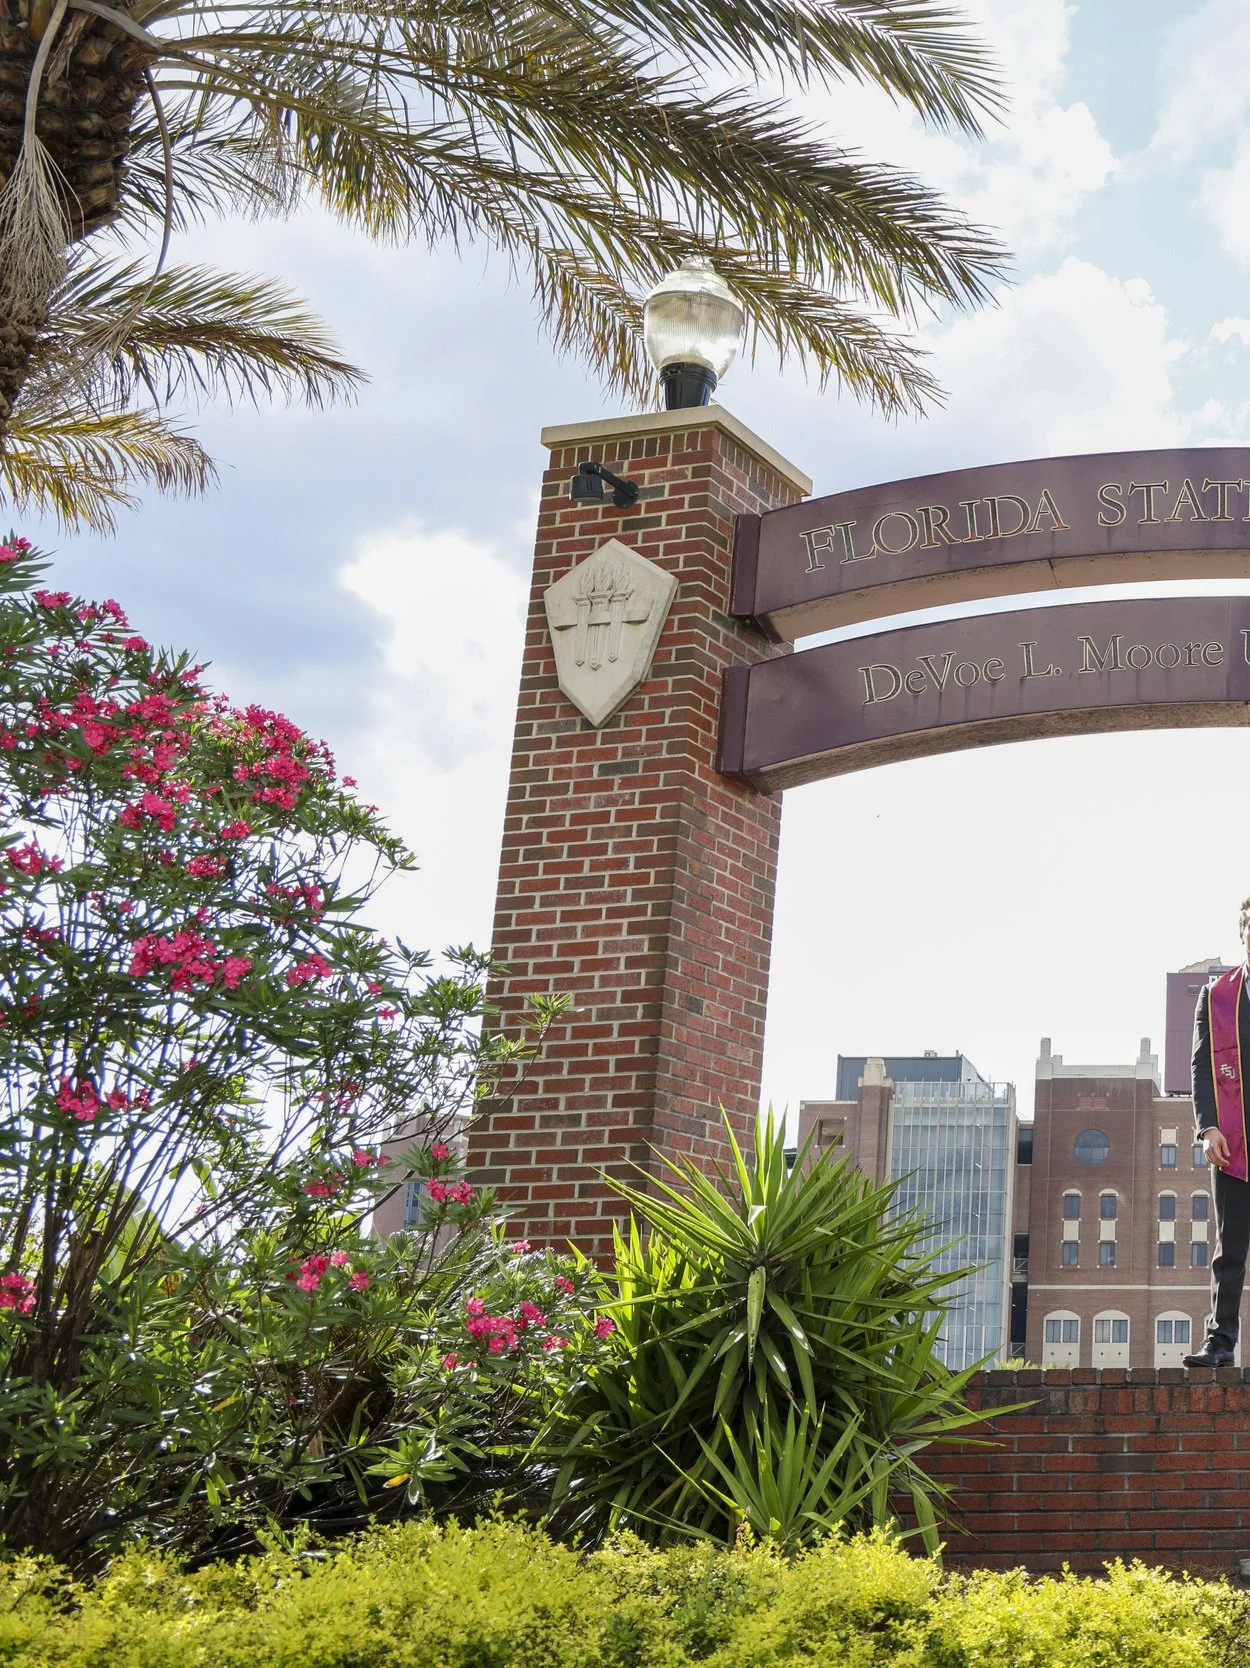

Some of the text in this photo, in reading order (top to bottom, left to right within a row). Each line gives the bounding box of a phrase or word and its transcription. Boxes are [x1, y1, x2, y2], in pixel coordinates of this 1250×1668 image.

[799, 489, 1069, 574] FLORIDA
[859, 652, 1005, 705] DeVoe
[1020, 641, 1062, 680] L.
[1079, 634, 1224, 673] Moore
